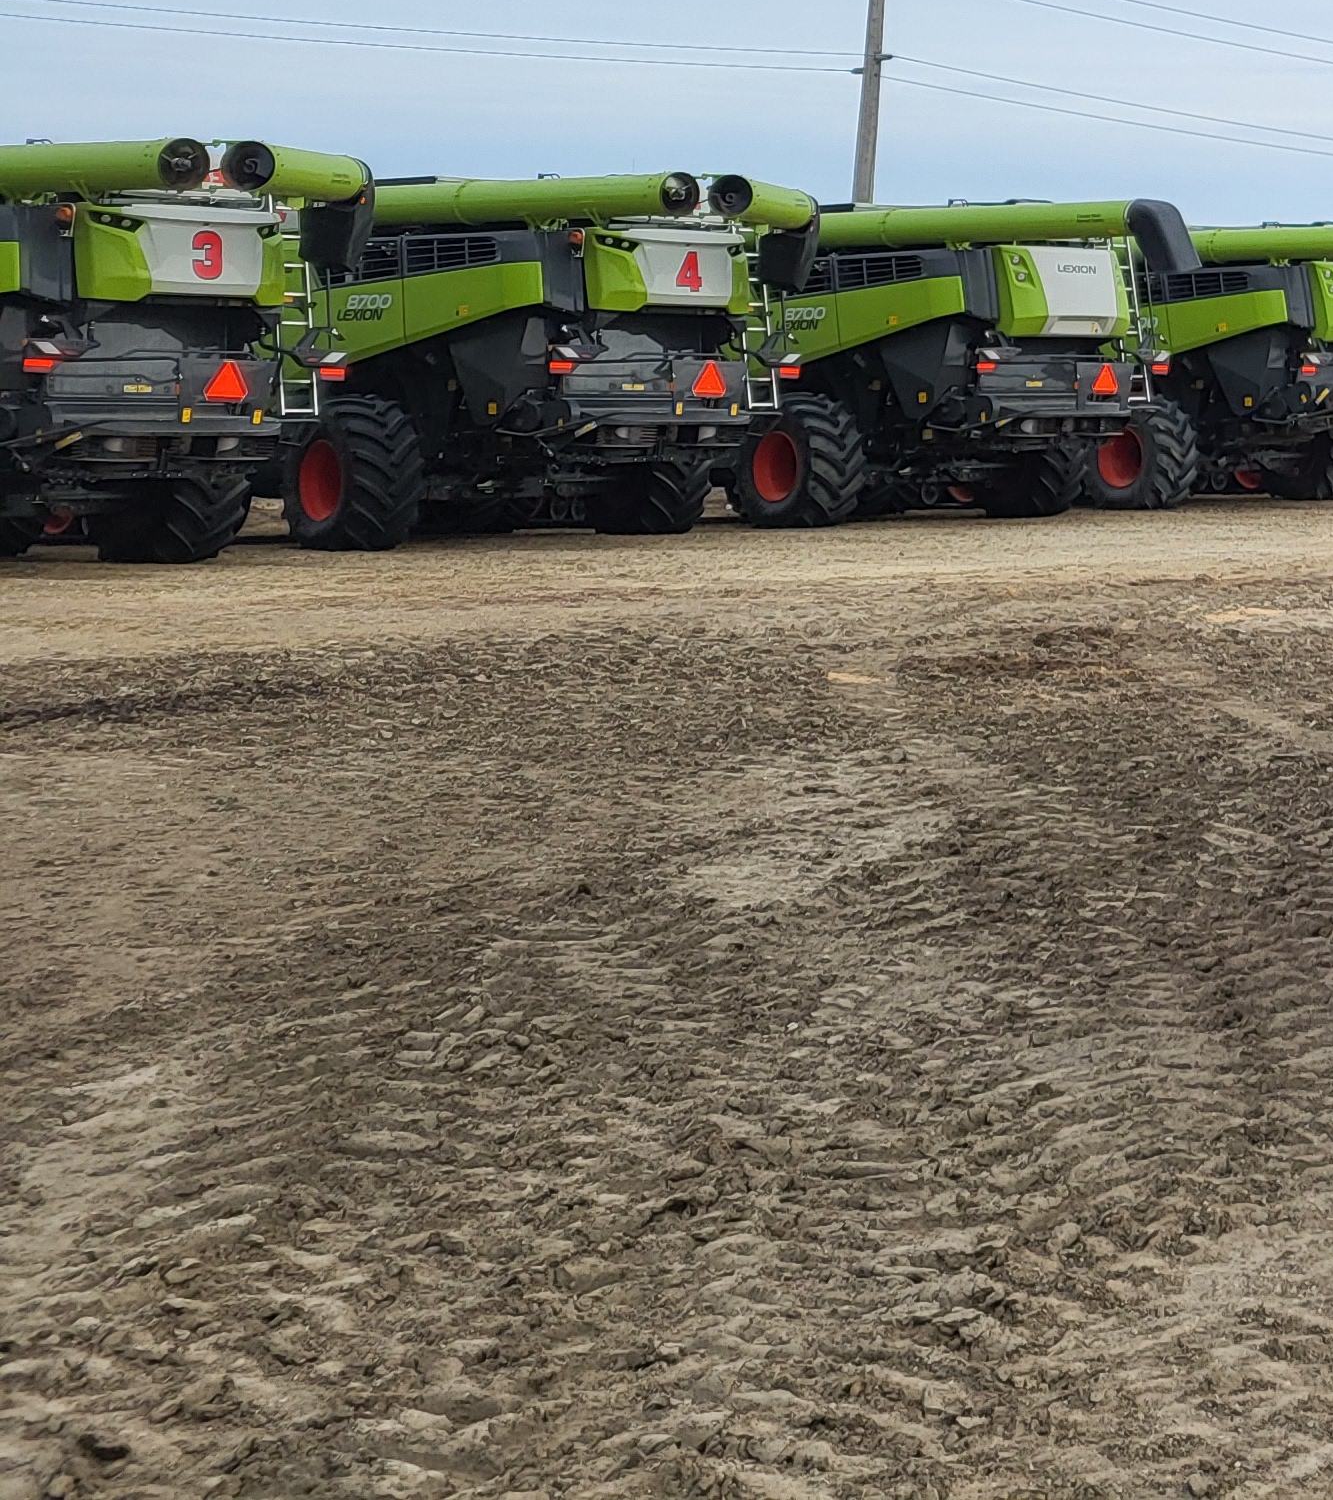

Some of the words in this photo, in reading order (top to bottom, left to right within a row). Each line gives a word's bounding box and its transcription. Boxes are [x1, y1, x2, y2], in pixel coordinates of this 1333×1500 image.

[192, 230, 222, 280] 3
[676, 251, 702, 292] 4
[1057, 264, 1096, 274] LEXION
[346, 294, 392, 310] 8700
[337, 309, 383, 321] LEXION
[785, 307, 826, 321] 8700
[776, 320, 818, 331] LEXION
